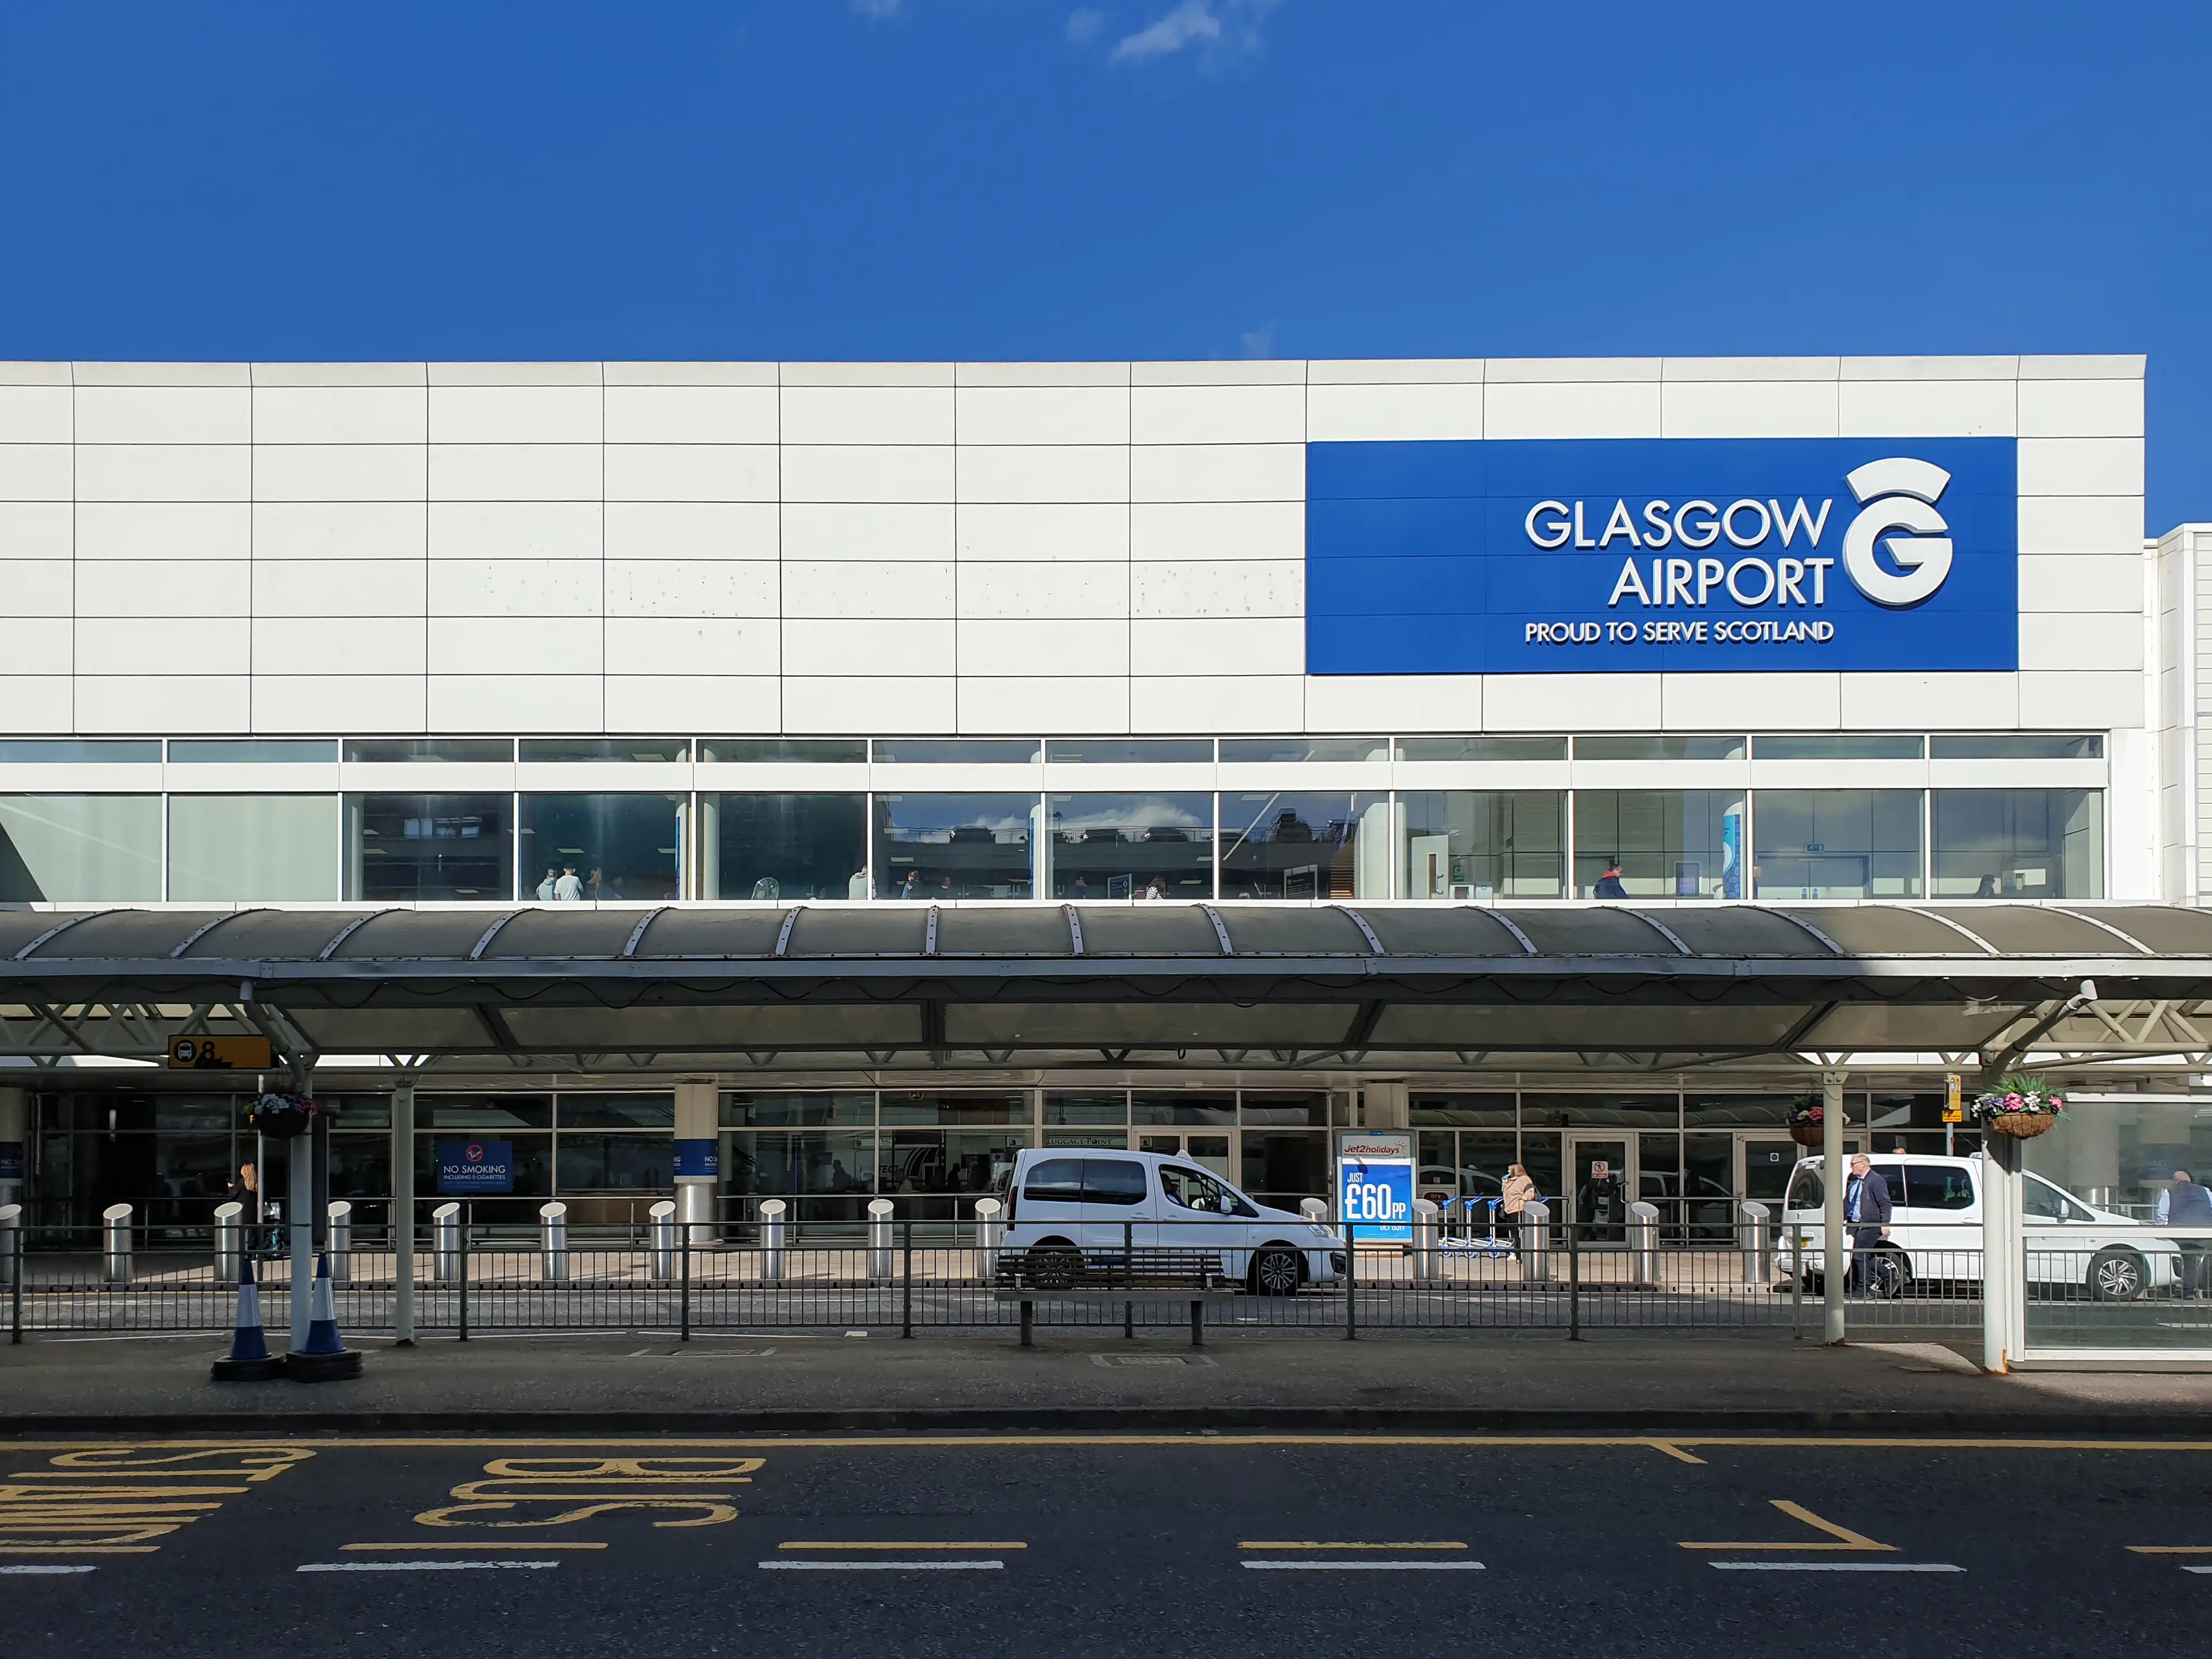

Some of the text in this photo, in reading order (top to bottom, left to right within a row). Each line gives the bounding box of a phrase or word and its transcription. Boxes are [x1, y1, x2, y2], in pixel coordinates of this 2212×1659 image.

[1525, 497, 1832, 548] GLASGOW
[1608, 556, 1834, 608] AIRPORT
[1525, 621, 1835, 644] PROUD TO SERVE SCOTLAND
[202, 1040, 215, 1062] 8
[444, 1165, 506, 1173] NO SMOKING
[1347, 1172, 1363, 1183] JUST
[1344, 1183, 1391, 1219] £60
[413, 1458, 766, 1527] BUS
